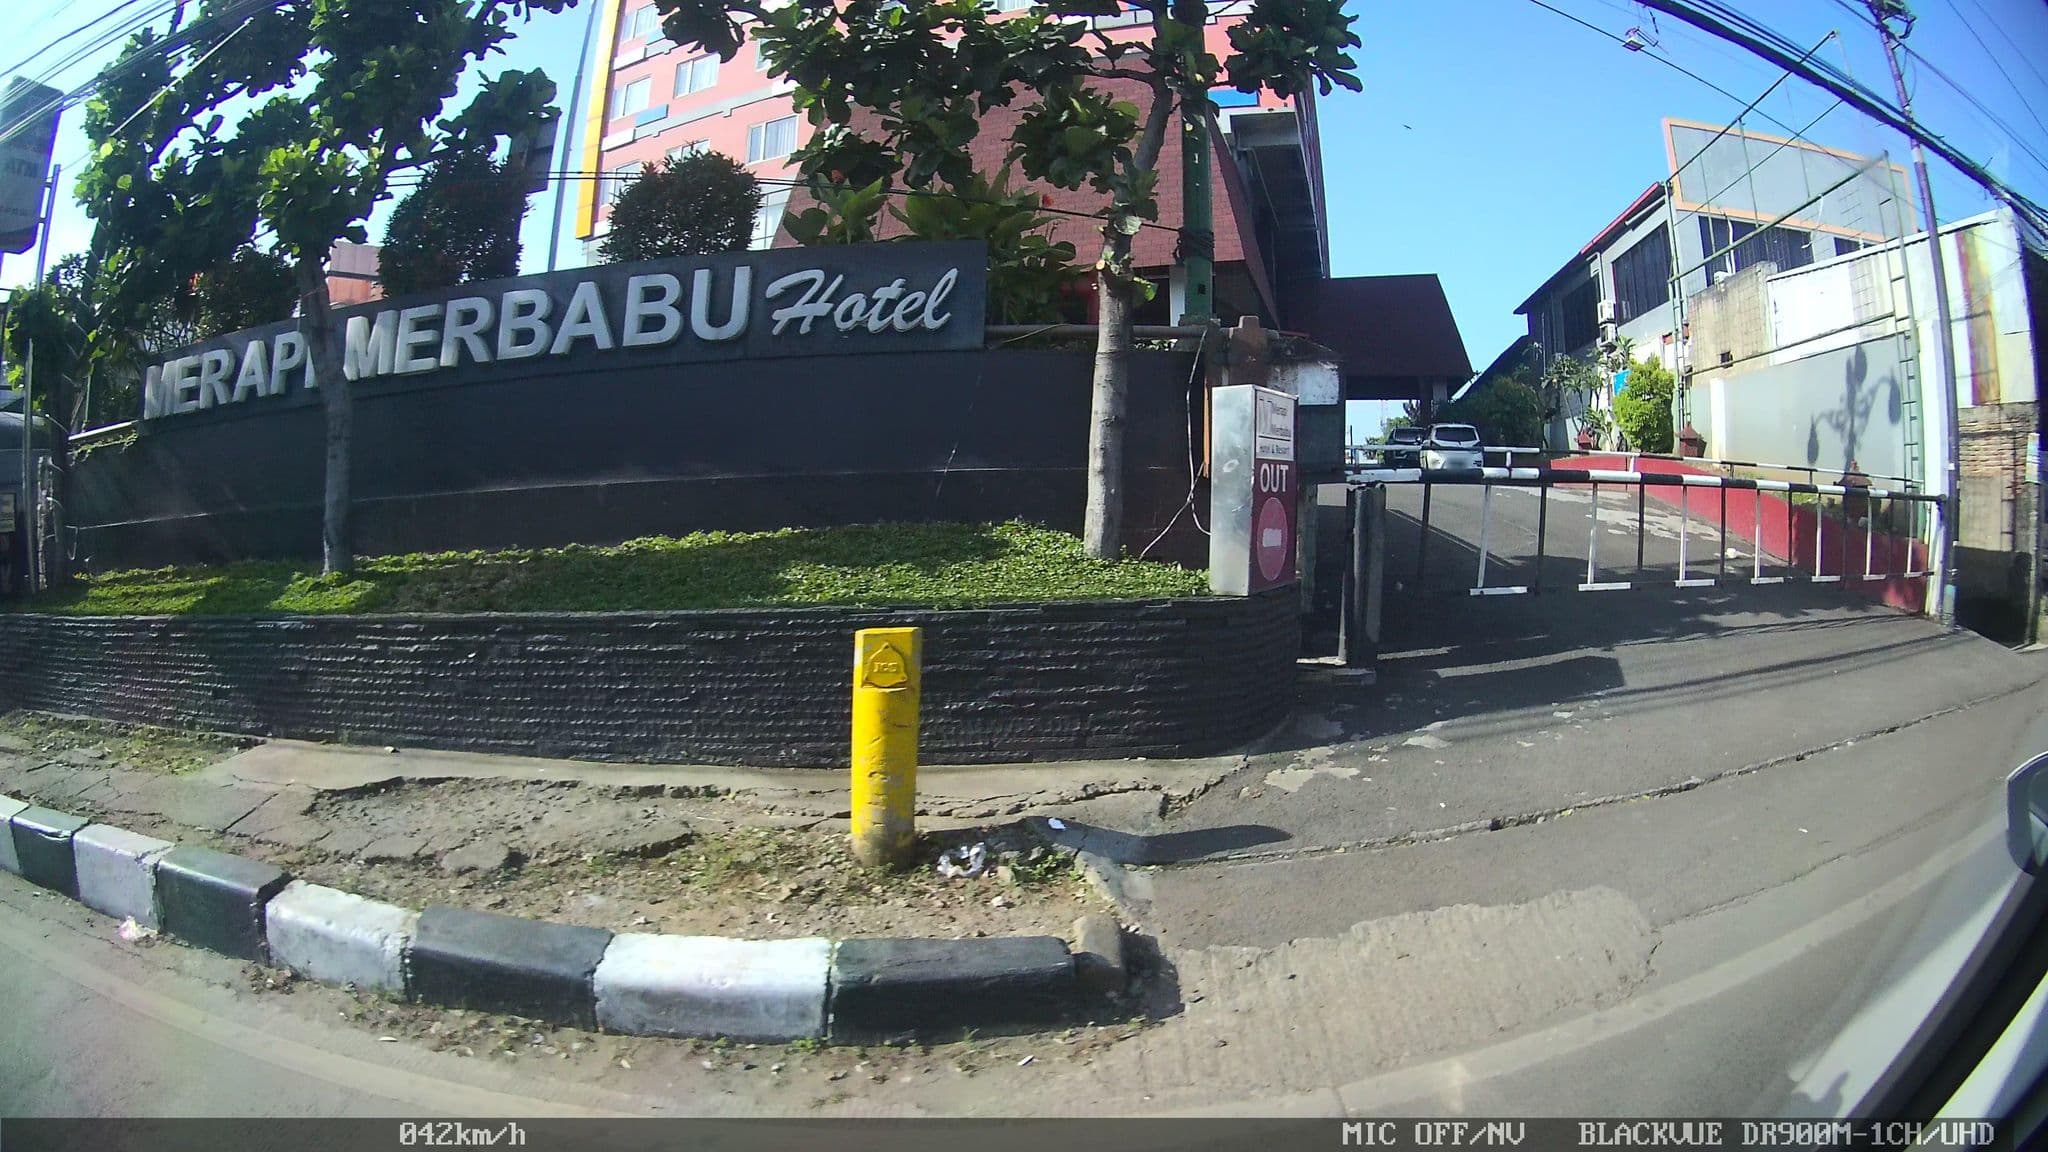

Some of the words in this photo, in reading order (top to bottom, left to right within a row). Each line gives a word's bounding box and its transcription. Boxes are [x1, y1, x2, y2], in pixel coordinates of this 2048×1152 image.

[343, 265, 752, 382] MERBABU
[766, 267, 959, 336] Hotel
[1260, 463, 1289, 492] OUT
